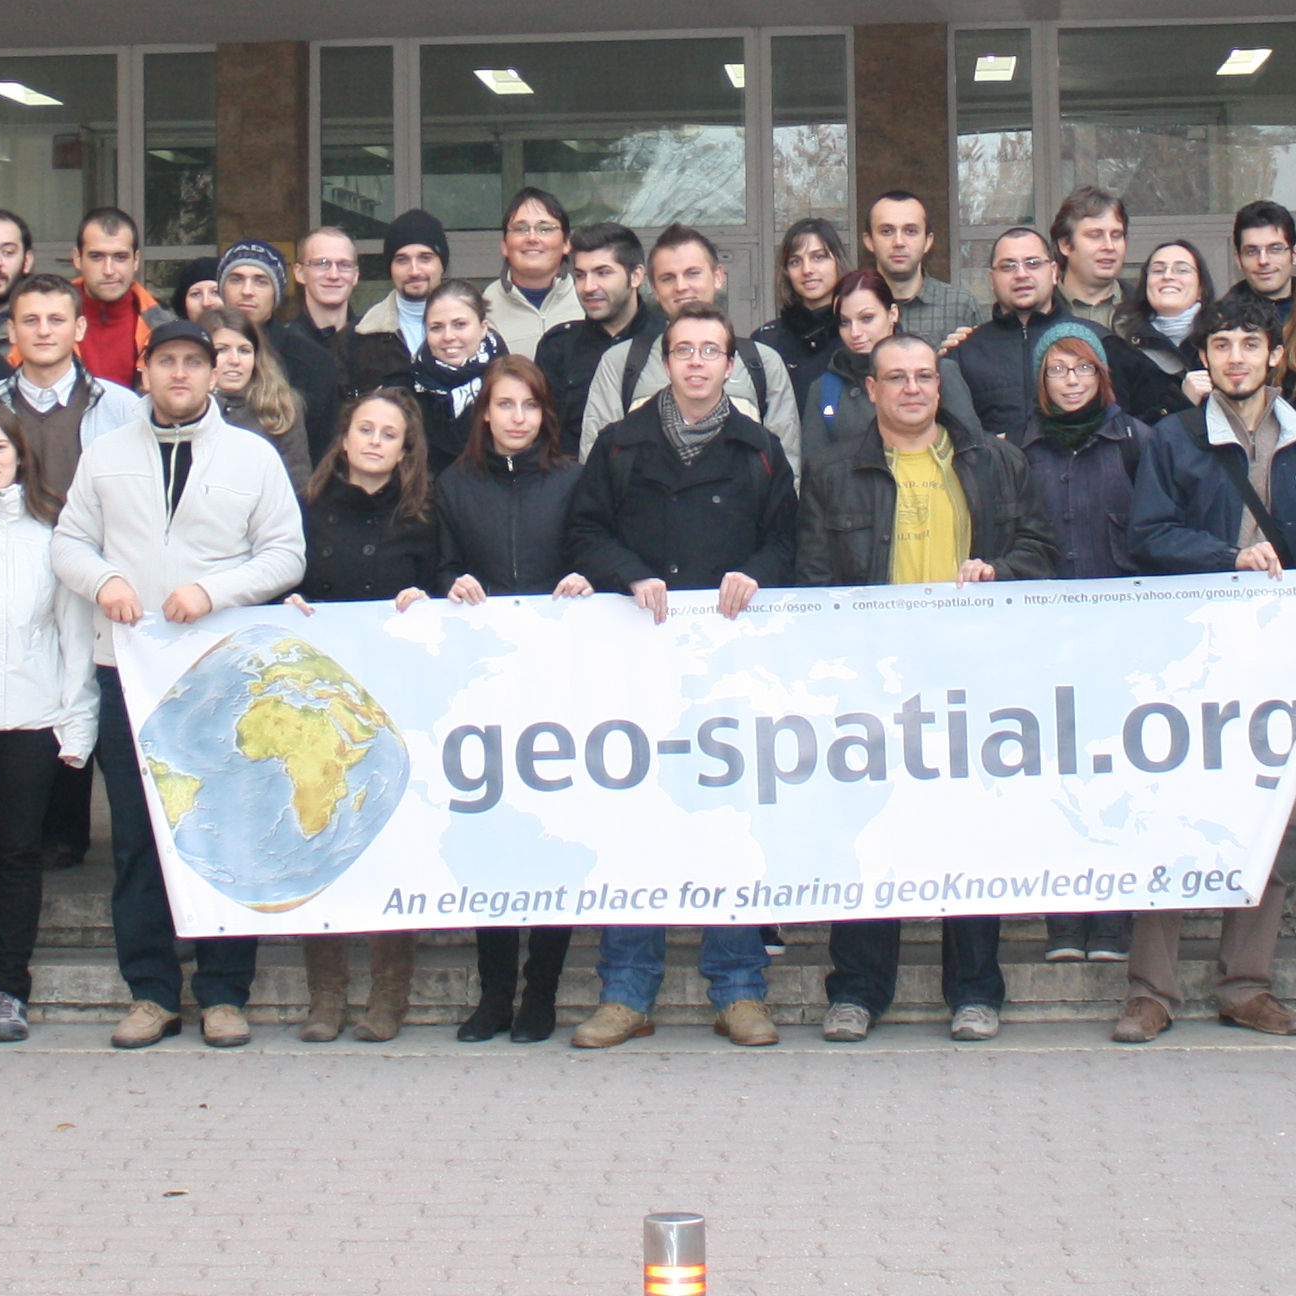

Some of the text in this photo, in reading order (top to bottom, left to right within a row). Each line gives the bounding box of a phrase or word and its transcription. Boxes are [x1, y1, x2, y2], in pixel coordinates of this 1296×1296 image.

[851, 595, 995, 611] contact@geo-spatial.org
[382, 887, 426, 917] An
[436, 884, 568, 918] elegant
[575, 882, 668, 916] place
[678, 880, 727, 909] for
[734, 876, 864, 911] sharing
[873, 868, 1138, 909] geoKnowledge
[1147, 865, 1172, 894] &
